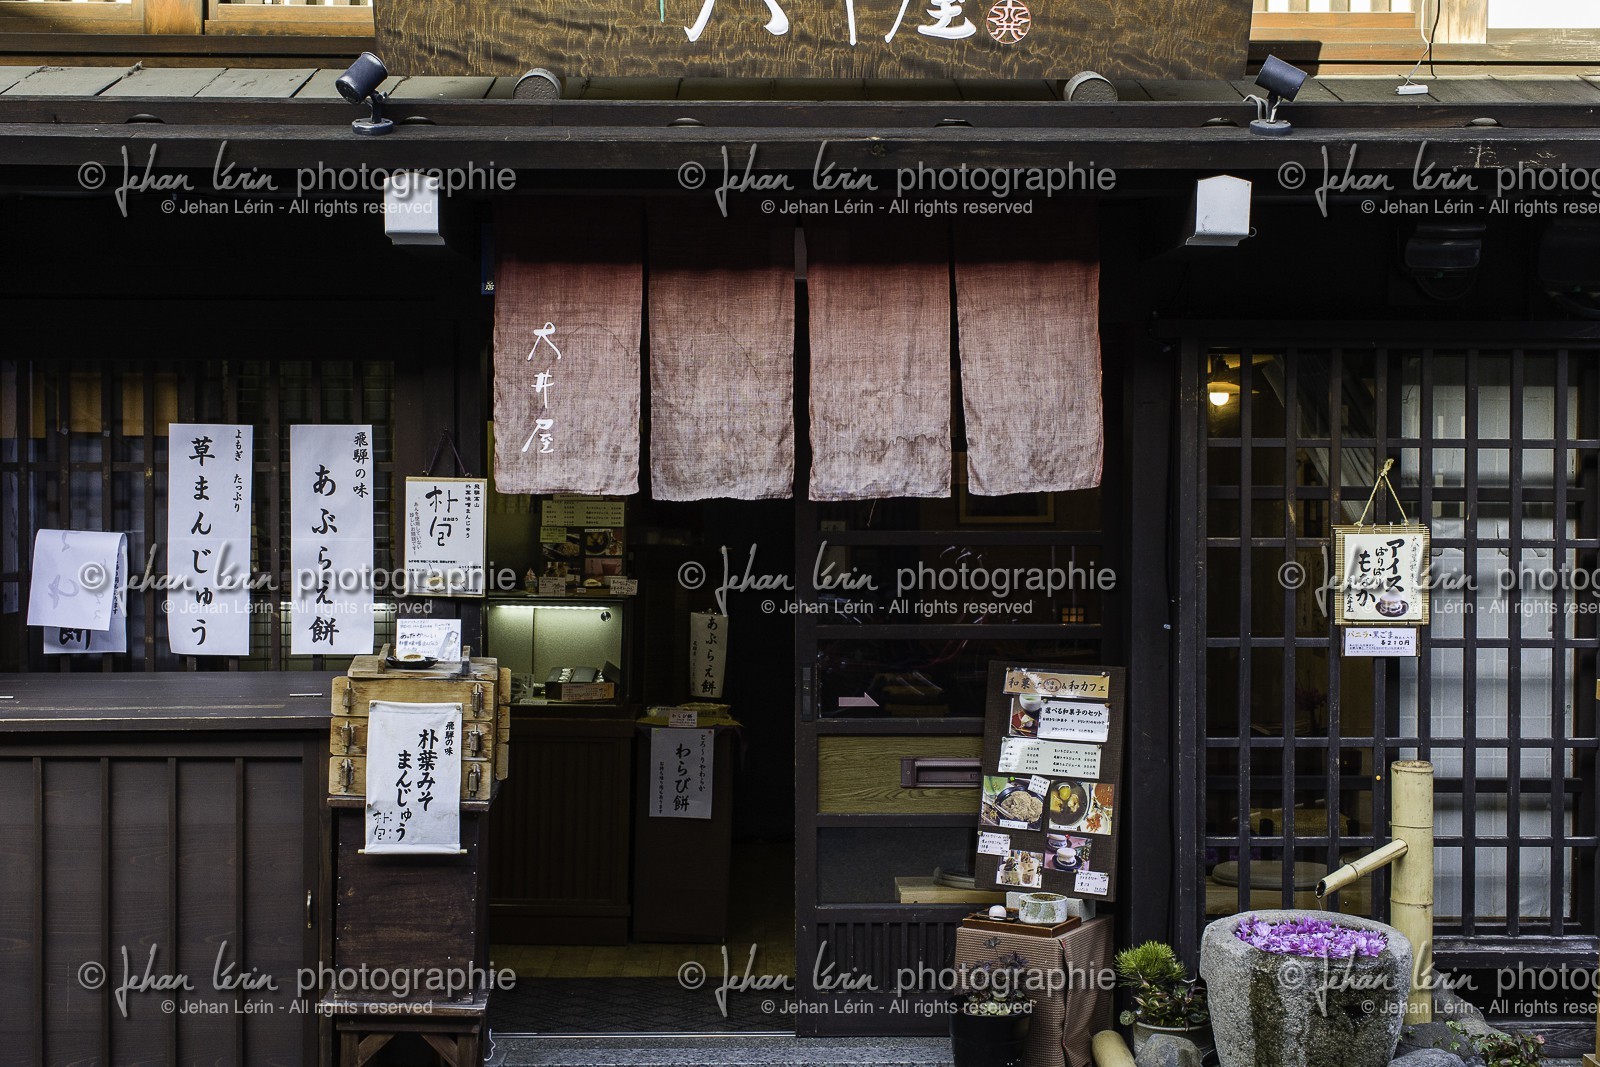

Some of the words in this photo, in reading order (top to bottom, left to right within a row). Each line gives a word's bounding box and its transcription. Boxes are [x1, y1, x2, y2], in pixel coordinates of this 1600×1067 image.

[521, 321, 562, 454] 大井屋
[234, 428, 243, 462] よもぎ
[352, 431, 370, 498] 飛騨の味
[232, 473, 243, 513] たっぷり
[425, 485, 459, 547] 朴包
[188, 436, 216, 646] 草まんじゅう
[308, 463, 340, 646] あぶらえ餅
[1385, 538, 1405, 592] アイス
[701, 616, 718, 696] あぶらえ餅
[444, 721, 455, 756] 飛騨の味
[1044, 706, 1103, 718] 選べる和菓子のセット
[395, 749, 413, 842] まんじゅう
[417, 729, 439, 811] 朴葉みそ
[673, 743, 691, 812] わらび餅
